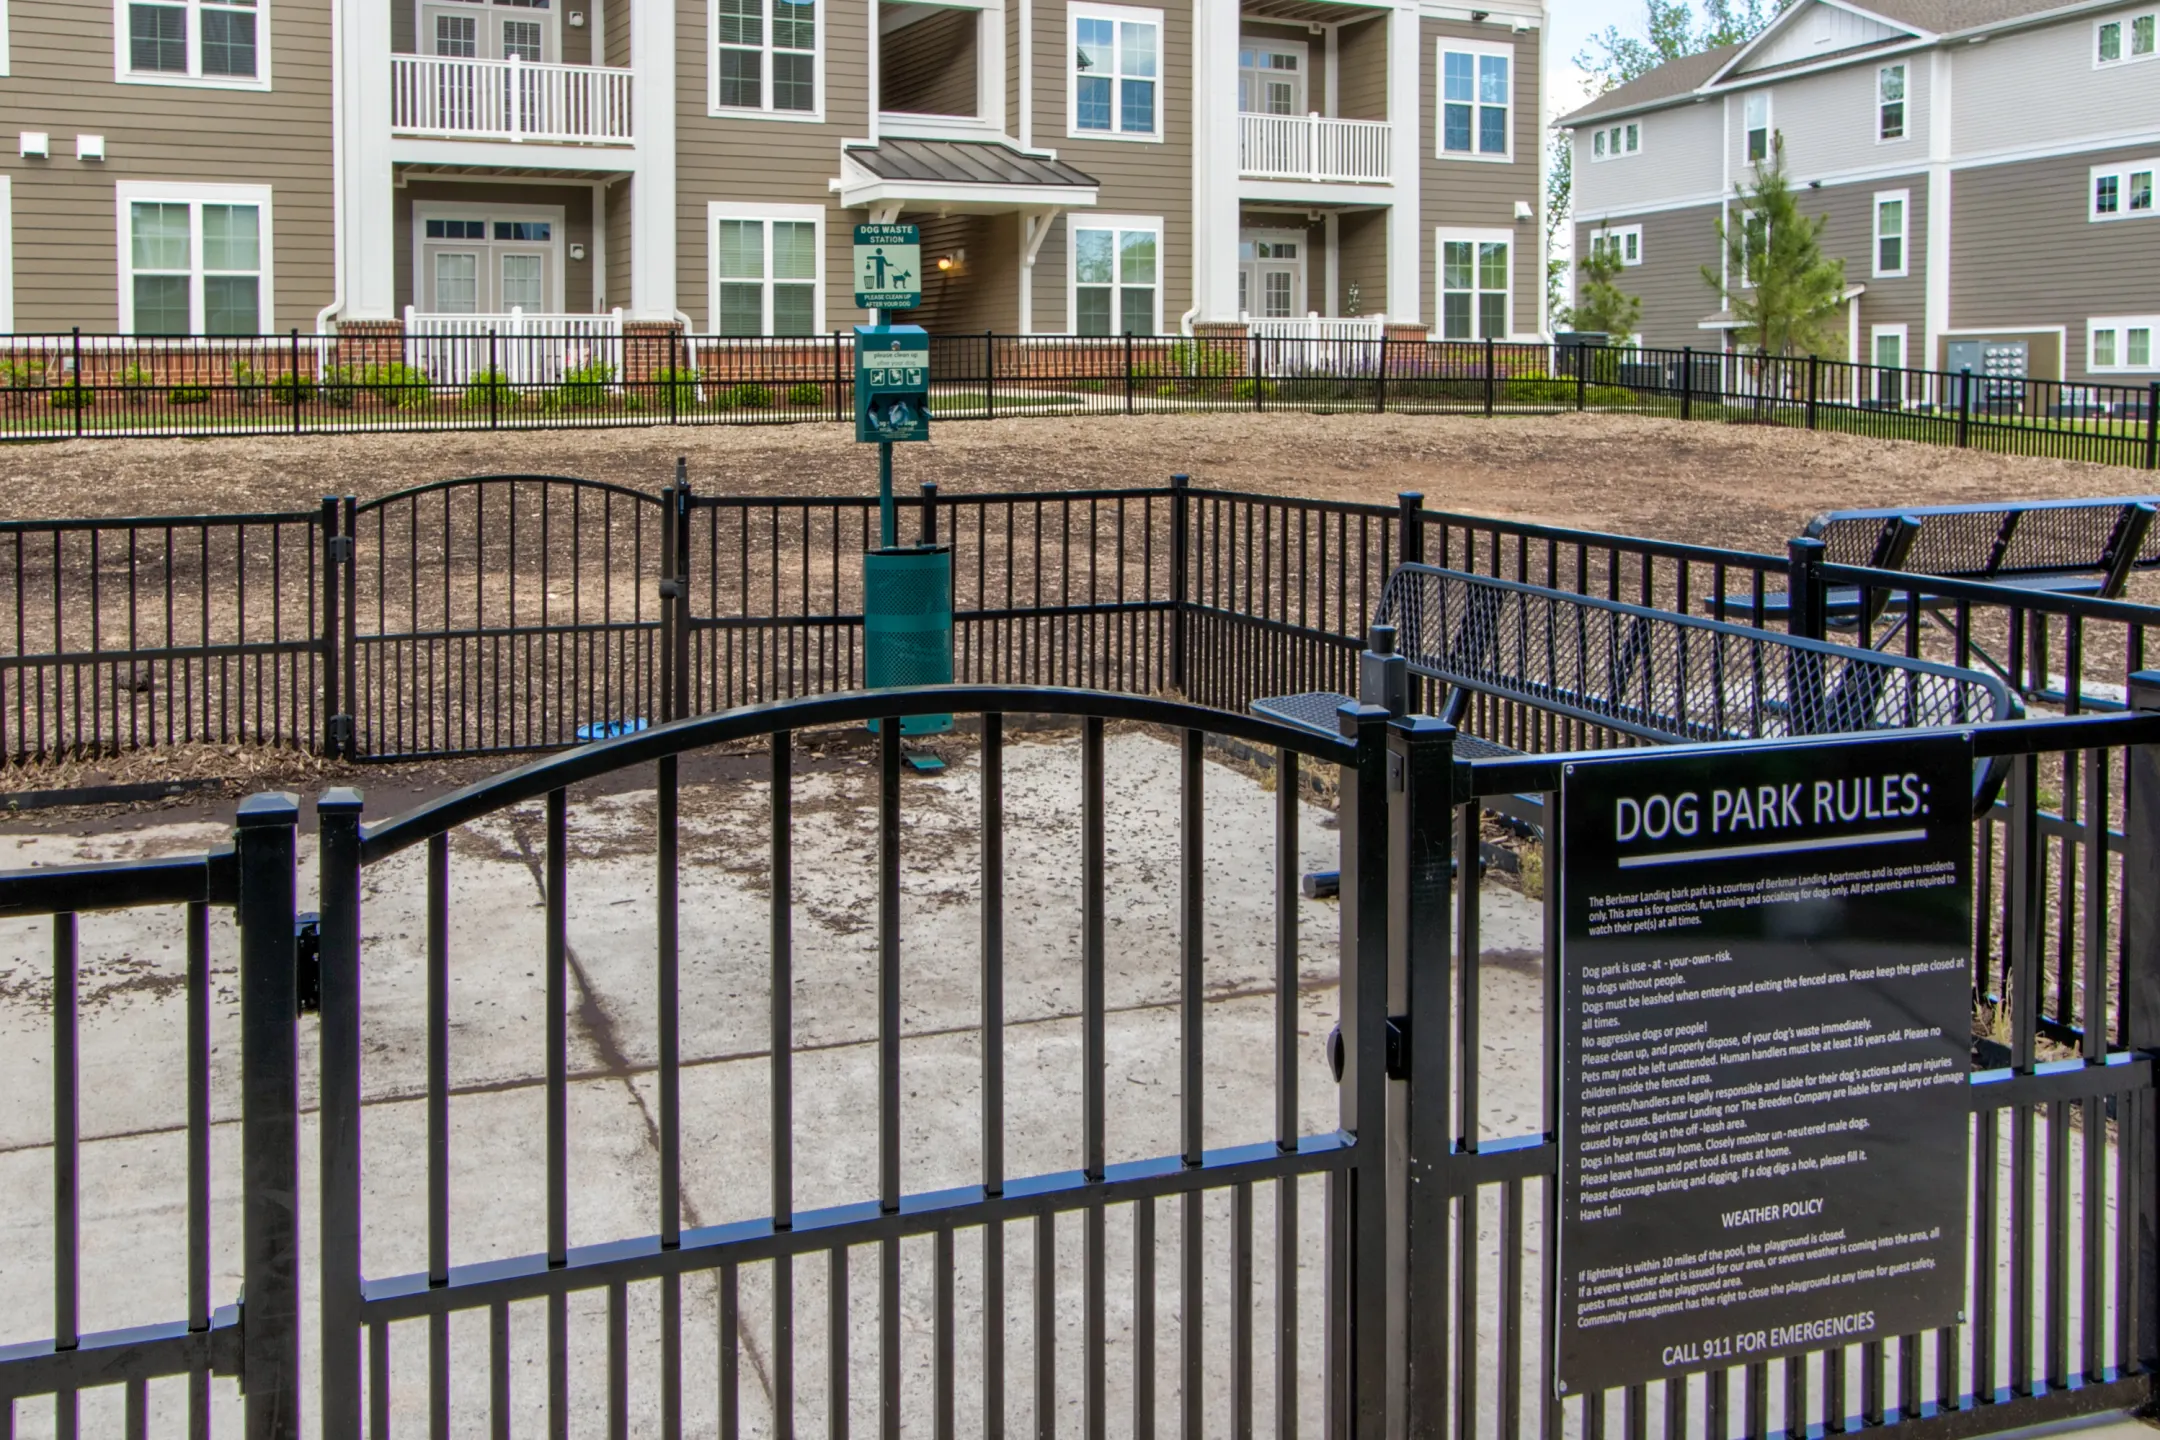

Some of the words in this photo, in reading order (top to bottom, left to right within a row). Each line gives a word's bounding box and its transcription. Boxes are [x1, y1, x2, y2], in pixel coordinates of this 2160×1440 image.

[860, 226, 879, 234] DOG
[1616, 791, 1698, 841] DOG
[1712, 782, 1801, 832] PARK
[1814, 772, 1928, 823] RULES:
[1588, 923, 1612, 935] watch
[1613, 922, 1632, 933] their
[1634, 919, 1656, 933] pet(s)
[1667, 917, 1677, 928] all
[1678, 917, 1701, 927] times.
[1582, 1001, 1603, 1014] Dogs
[1604, 998, 1627, 1010] must
[1641, 991, 1674, 1006] leashed
[1675, 990, 1699, 1002] when
[1700, 986, 1736, 999] entering
[1736, 982, 1753, 995] and
[1754, 980, 1782, 993] exiting
[1782, 977, 1798, 989] the
[1798, 973, 1826, 987] fenced
[1827, 974, 1848, 984] area.
[1849, 970, 1874, 981] Please
[1876, 967, 1895, 979] keep
[1896, 964, 1910, 976] the
[1910, 963, 1928, 977] gate
[1929, 958, 1954, 972] closed
[1596, 982, 1617, 995] dogs
[1618, 978, 1652, 991] without
[1653, 974, 1685, 990] people.
[1581, 1018, 1592, 1030] all
[1593, 1018, 1620, 1029] times.
[1581, 1053, 1609, 1065] Please
[1610, 1050, 1634, 1062] clean
[1635, 1049, 1649, 1060] up,
[1650, 1043, 1667, 1056] and
[1668, 1039, 1704, 1056] properly
[1705, 1037, 1740, 1050] dispose,
[1752, 1032, 1771, 1045] your
[1795, 1024, 1820, 1037] waste
[1820, 1017, 1872, 1034] immediately.
[1596, 1032, 1640, 1048] aggressive
[1641, 1029, 1662, 1041] dogs
[1674, 1021, 1707, 1039] people!
[1581, 1071, 1600, 1083] Pets
[1601, 1070, 1620, 1081] may
[1621, 1066, 1636, 1077] not
[1650, 1061, 1666, 1074] left
[1667, 1054, 1718, 1071] unattended.
[1720, 1053, 1750, 1065] Human
[1751, 1047, 1787, 1060] handlers
[1788, 1043, 1809, 1056] must
[1832, 1037, 1852, 1050] least
[1864, 1035, 1886, 1048] years
[1886, 1030, 1902, 1043] old.
[1903, 1029, 1929, 1041] Please
[1580, 1087, 1616, 1100] children
[1618, 1082, 1644, 1095] inside
[1644, 1080, 1660, 1092] the
[1660, 1075, 1690, 1090] fenced
[1690, 1075, 1712, 1086] area.
[1581, 1105, 1596, 1117] Pet
[1597, 1096, 1670, 1118] parents/handlers
[1671, 1095, 1685, 1105] are
[1686, 1089, 1714, 1104] legally
[1715, 1082, 1762, 1100] responsible
[1763, 1079, 1780, 1092] and
[1781, 1077, 1804, 1090] liable
[1804, 1075, 1817, 1087] for
[1818, 1073, 1838, 1085] their
[1861, 1067, 1890, 1079] actions
[1890, 1062, 1906, 1075] and
[1907, 1062, 1922, 1074] any
[1923, 1058, 1952, 1072] injuries
[1580, 1174, 1608, 1186] Please
[1609, 1170, 1632, 1182] leave
[1633, 1166, 1664, 1178] human
[1665, 1161, 1682, 1174] and
[1683, 1159, 1698, 1174] pet
[1698, 1155, 1719, 1169] food
[1728, 1152, 1753, 1164] treats
[1764, 1148, 1791, 1159] home.
[1580, 1191, 1608, 1203] Please
[1608, 1184, 1655, 1199] discourage
[1656, 1178, 1688, 1192] barking
[1689, 1174, 1706, 1187] and
[1706, 1171, 1740, 1186] digging.
[1755, 1165, 1772, 1178] dog
[1772, 1163, 1790, 1176] digs
[1798, 1158, 1818, 1170] hole,
[1819, 1155, 1846, 1170] please
[1846, 1151, 1858, 1163] fill
[1858, 1150, 1867, 1161] it.
[1579, 1210, 1602, 1221] Have
[1602, 1205, 1621, 1218] fun!
[1721, 1204, 1779, 1227] WEATHER
[1782, 1197, 1823, 1218] POLICY
[1586, 1267, 1623, 1283] lightning
[1633, 1259, 1660, 1273] within
[1674, 1254, 1696, 1266] miles
[1708, 1249, 1722, 1261] the
[1724, 1245, 1745, 1261] pool,
[1746, 1243, 1761, 1255] the
[1764, 1234, 1809, 1255] playground
[1818, 1228, 1846, 1243] closed.
[1577, 1299, 1605, 1314] guests
[1606, 1295, 1628, 1307] must
[1629, 1291, 1657, 1304] vacate
[1658, 1288, 1673, 1299] the
[1674, 1280, 1721, 1299] playground
[1722, 1279, 1742, 1289] area.
[1662, 1342, 1700, 1365] CALL
[1702, 1336, 1731, 1359] 911
[1736, 1330, 1766, 1352] FOR
[1770, 1310, 1875, 1347] EMERGENCIES
